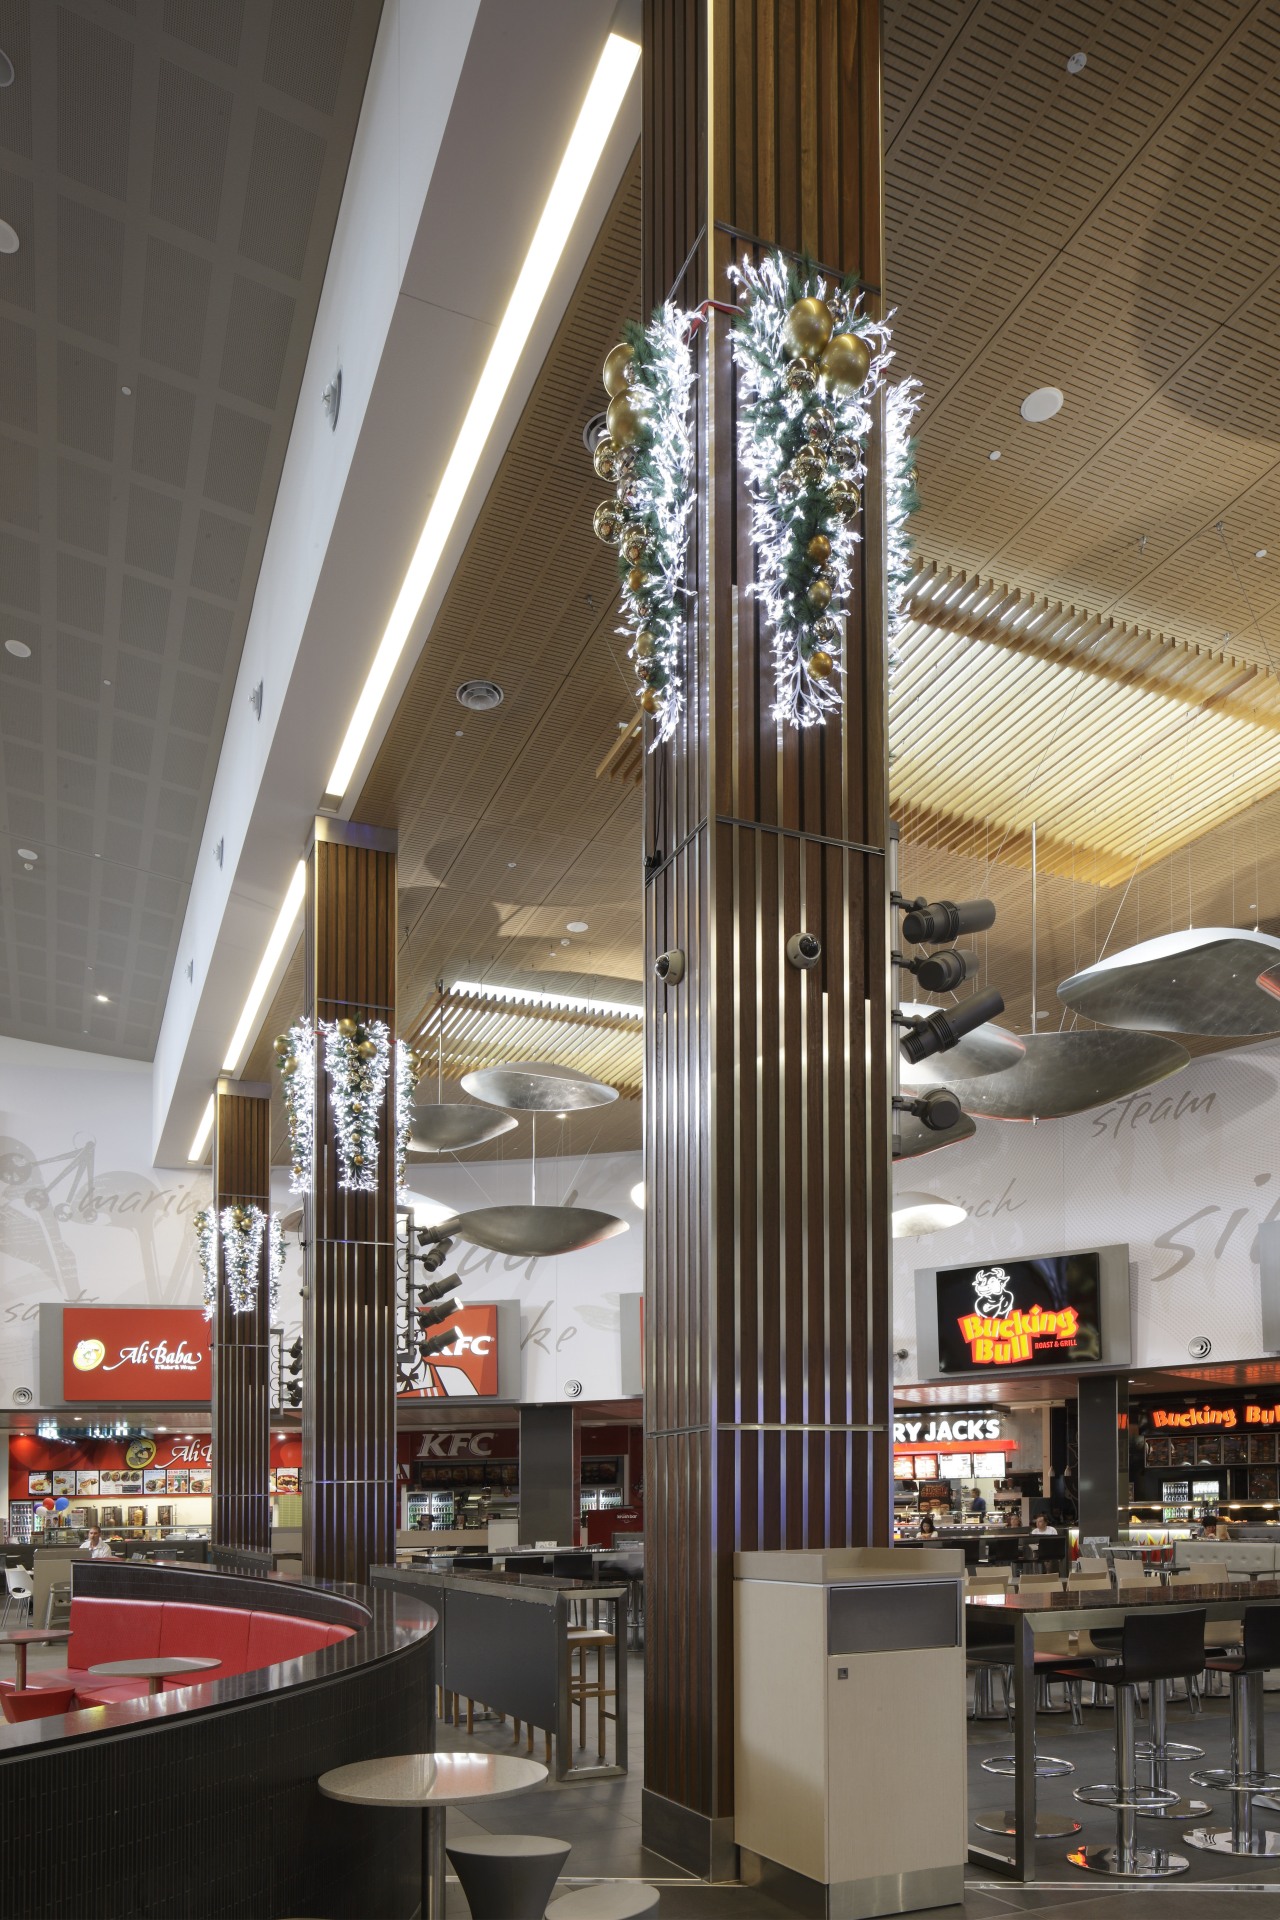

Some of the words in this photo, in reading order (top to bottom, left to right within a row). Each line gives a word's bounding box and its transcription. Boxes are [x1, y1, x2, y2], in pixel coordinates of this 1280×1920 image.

[1091, 1090, 1217, 1139] steam
[958, 1304, 1080, 1340] Bucking
[102, 1340, 150, 1371] Ali
[149, 1340, 203, 1365] Baba
[971, 1334, 1033, 1364] Bull
[1034, 1341, 1054, 1350] ROAST
[1060, 1339, 1078, 1348] GRILL
[924, 1418, 1000, 1442] JACK'S
[1152, 1404, 1237, 1428] Bucking
[154, 1439, 201, 1469] Ali
[416, 1432, 495, 1458] KFC
